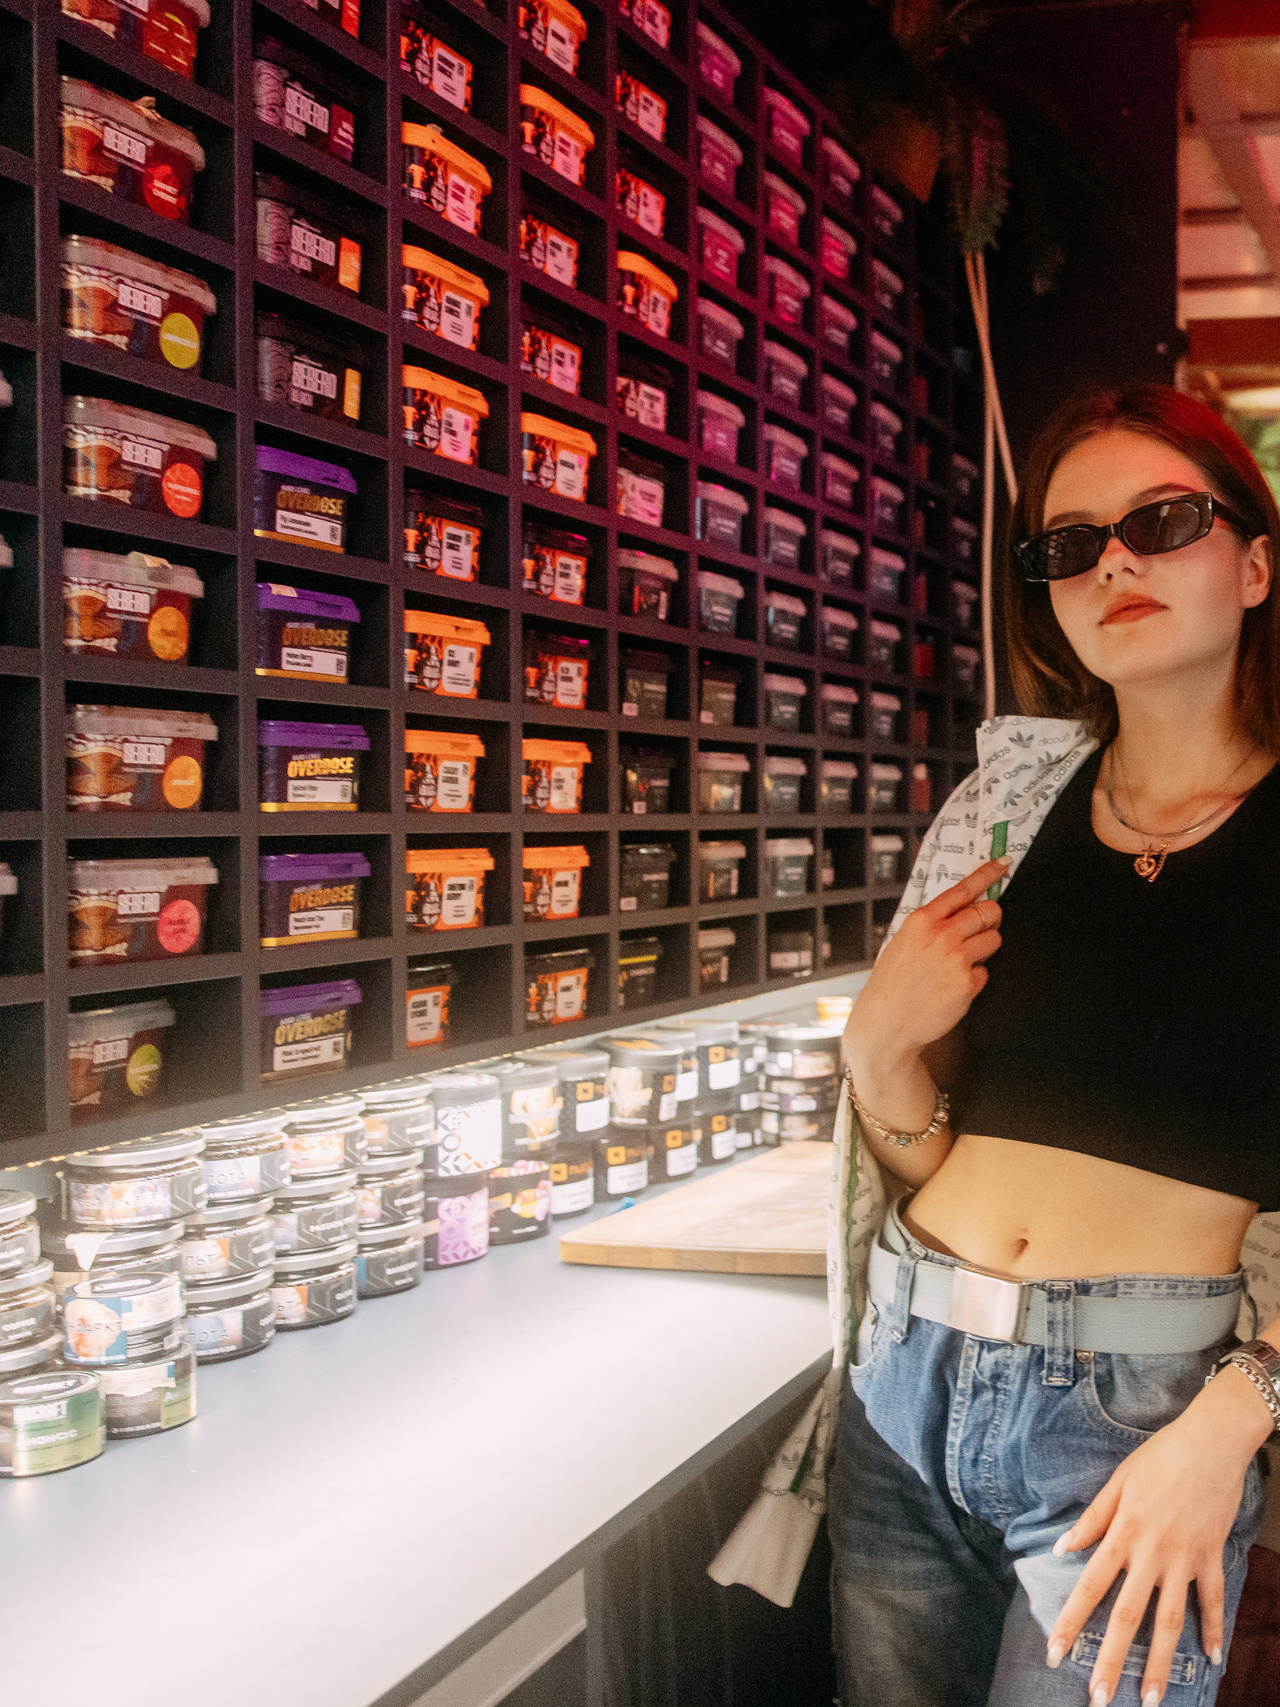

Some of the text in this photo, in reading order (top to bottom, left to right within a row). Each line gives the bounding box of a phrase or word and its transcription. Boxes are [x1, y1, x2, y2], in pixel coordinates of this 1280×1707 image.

[287, 757, 354, 778] OVERDOSE
[1053, 750, 1081, 782] adidas
[289, 884, 355, 912] OVERDOSE
[275, 1009, 346, 1045] OVERDOSE
